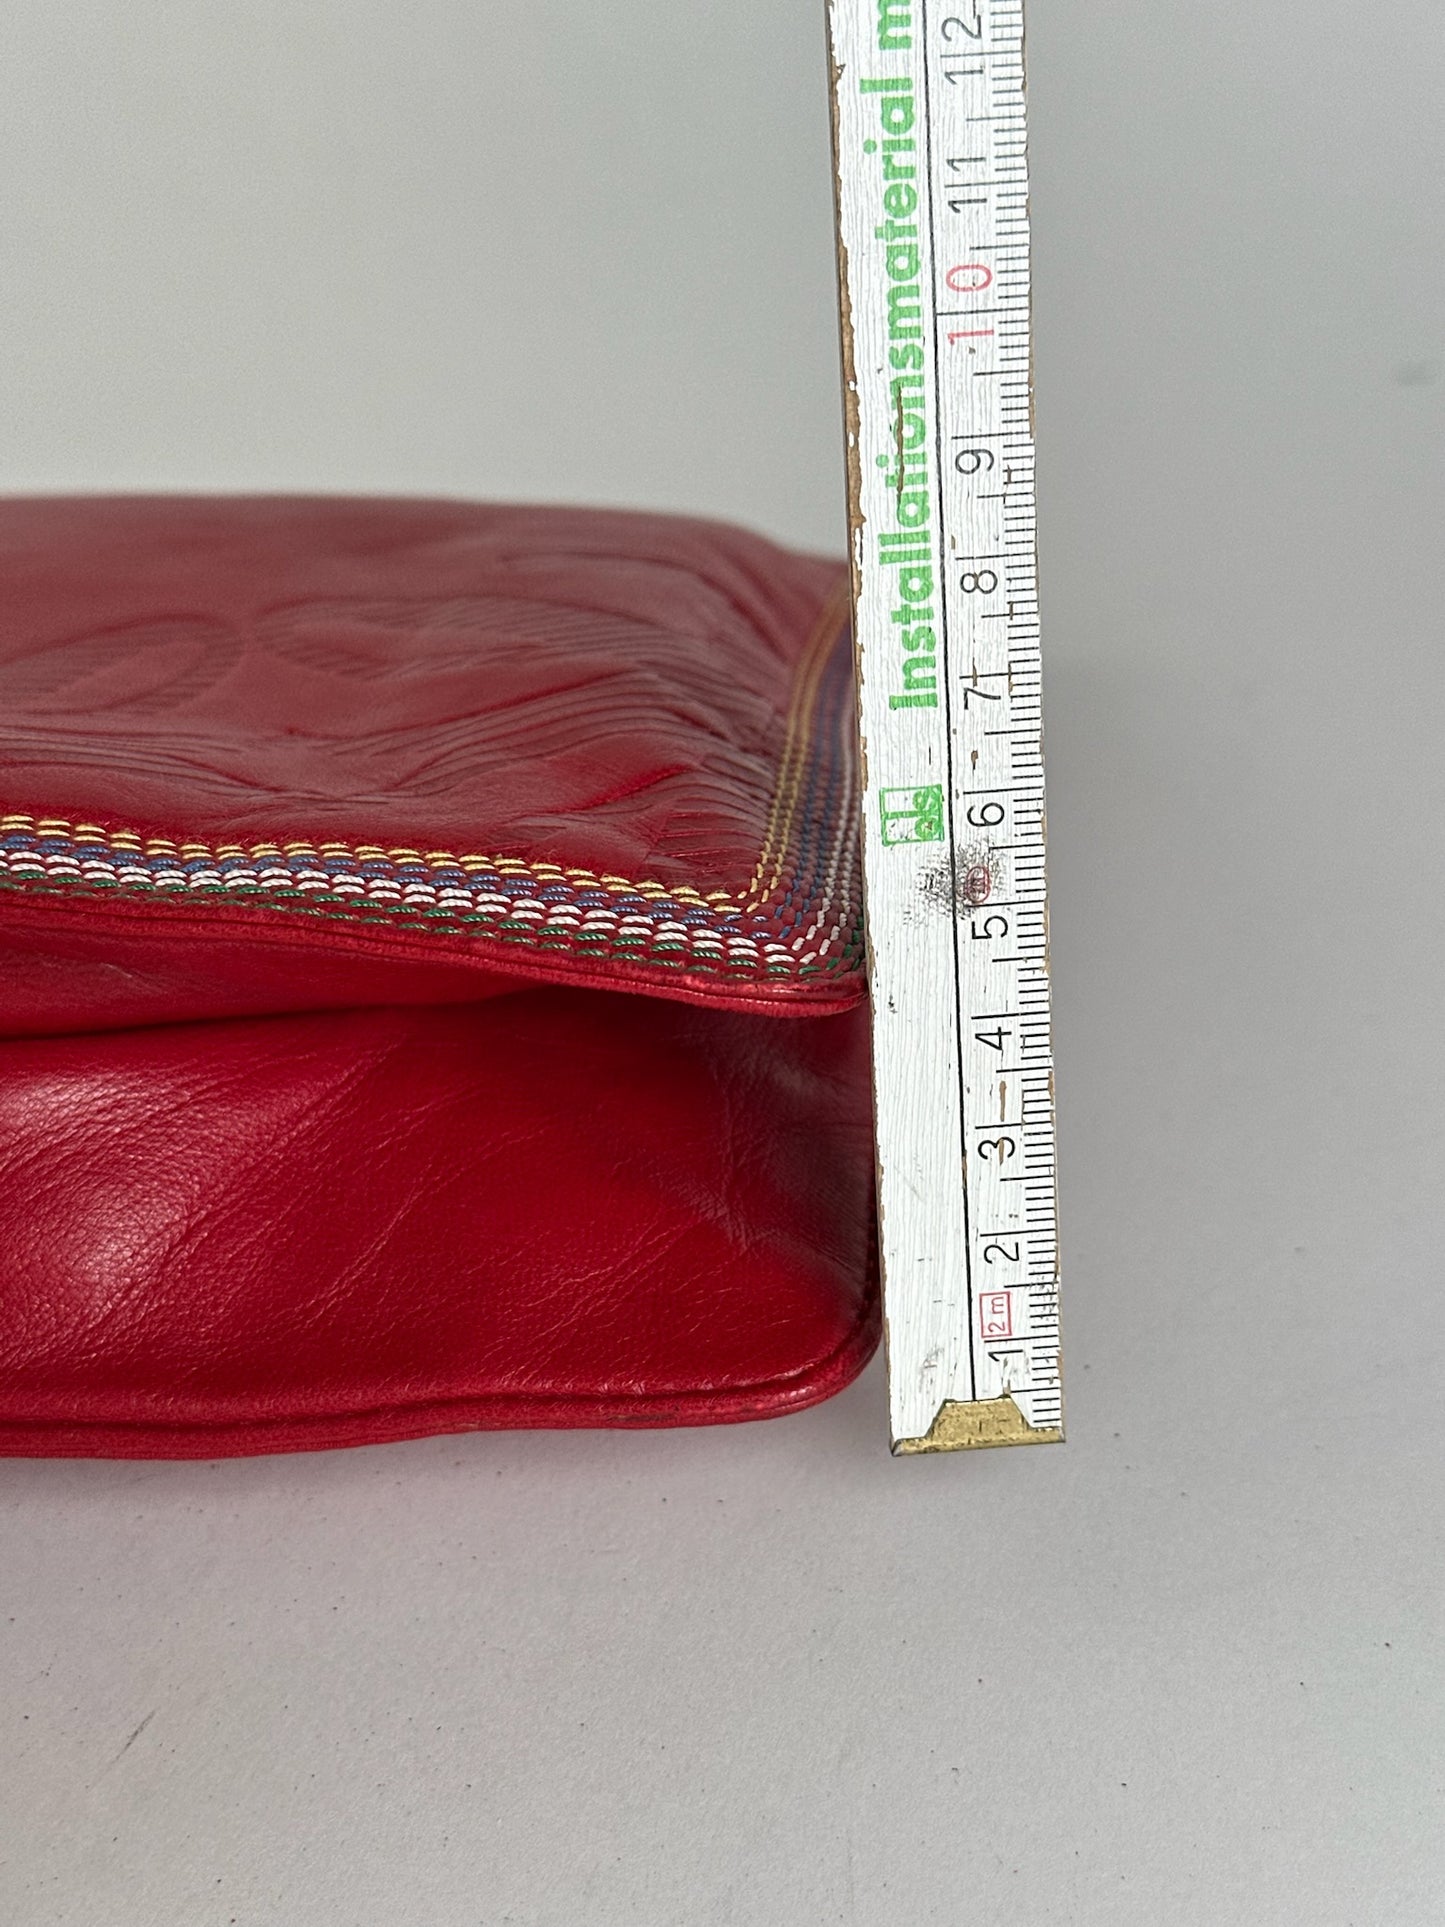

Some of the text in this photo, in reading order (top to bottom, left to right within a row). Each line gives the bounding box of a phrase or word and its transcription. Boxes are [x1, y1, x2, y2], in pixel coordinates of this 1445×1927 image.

[941, 14, 984, 85] 12
[946, 157, 988, 213] 11
[946, 264, 994, 345] 10
[859, 77, 938, 711] Installationsmaterial
[954, 448, 995, 475] 9
[959, 569, 998, 594] 8
[963, 686, 1002, 711] 7
[967, 802, 1005, 827] 6
[971, 915, 1009, 940] 5
[974, 1026, 1012, 1051] 4
[977, 1136, 1016, 1160] 3
[983, 1242, 1020, 1264] 2
[987, 1349, 1024, 1362] 1
